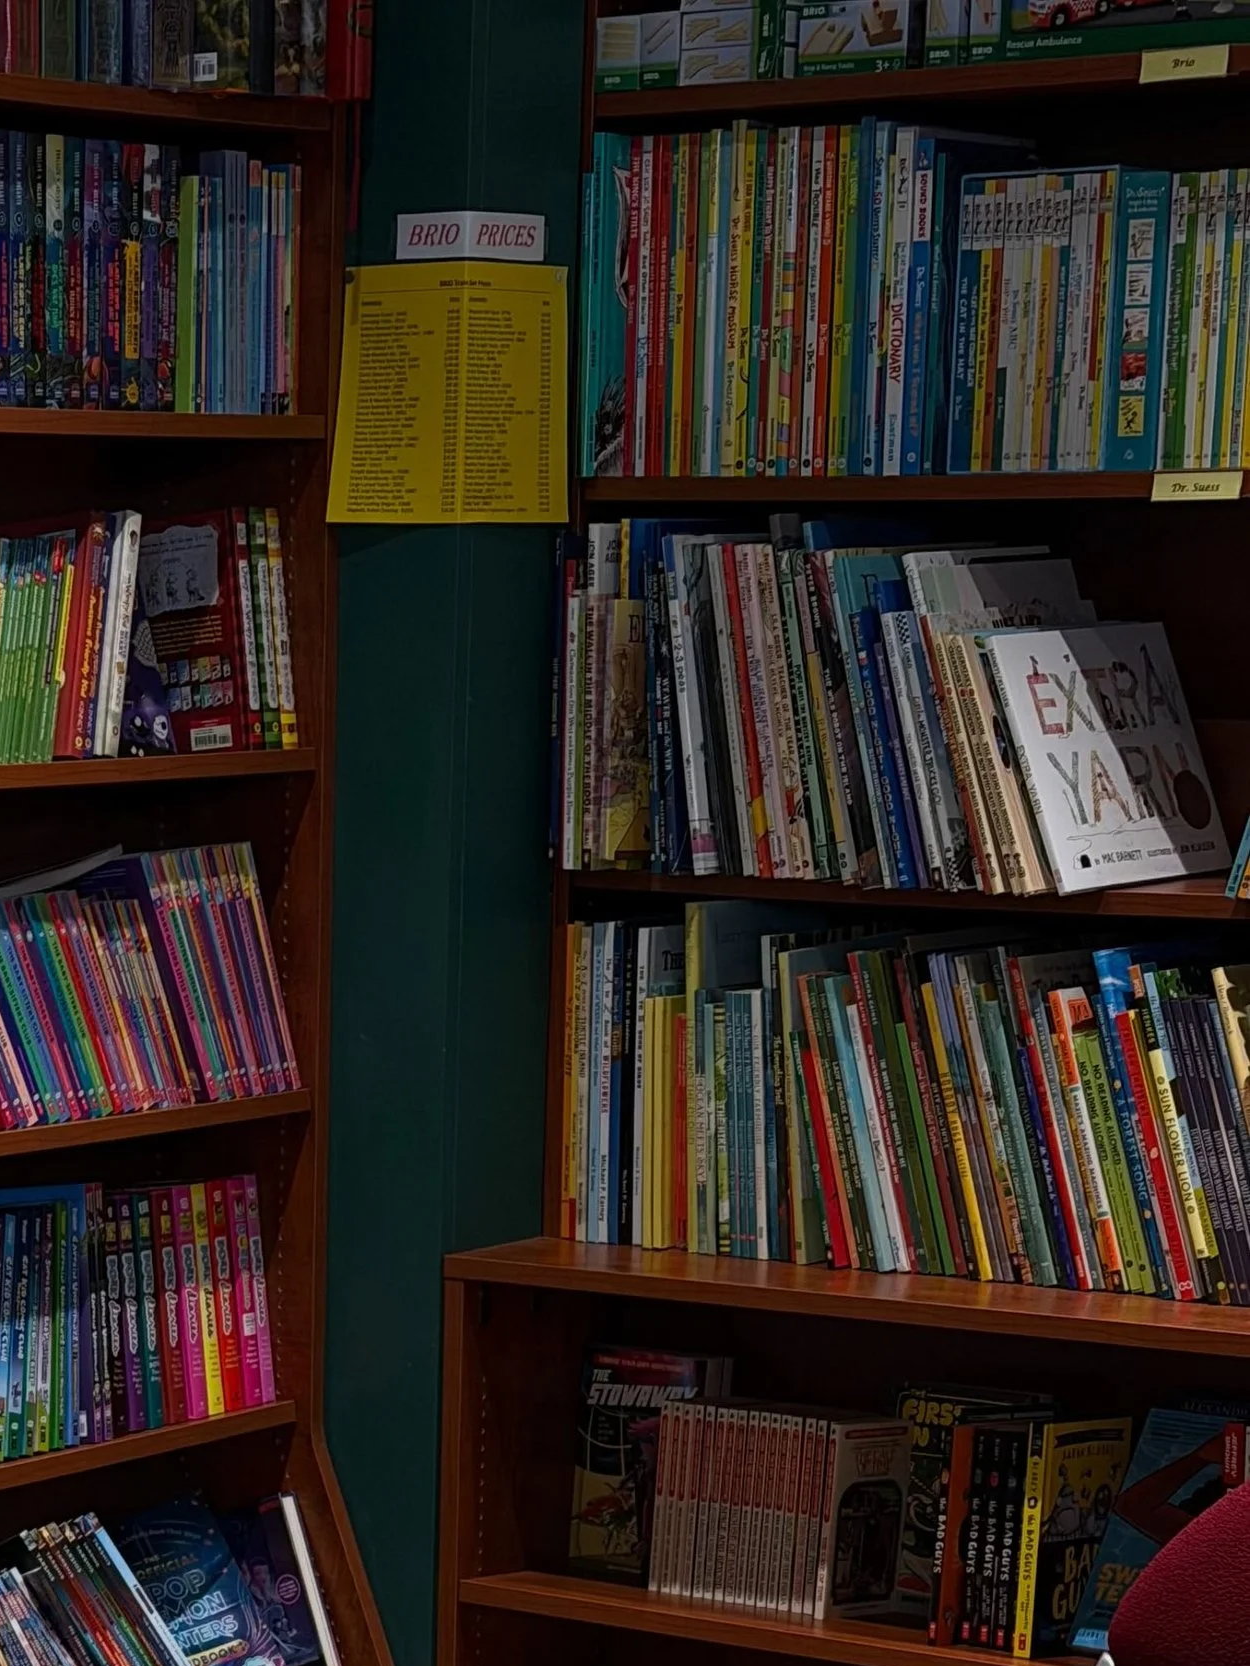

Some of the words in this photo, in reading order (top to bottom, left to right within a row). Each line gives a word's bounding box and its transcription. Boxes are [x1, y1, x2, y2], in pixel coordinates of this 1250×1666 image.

[918, 173, 928, 206] SOUND
[408, 223, 460, 246] BRIO
[476, 225, 536, 248] PRICES
[917, 207, 927, 238] BOOKS
[888, 302, 904, 384] DICTIONARY
[1171, 482, 1191, 493] Dr.
[1026, 642, 1182, 737] EXTRA
[1026, 781, 1043, 815] YARN
[1046, 742, 1191, 826] YARN
[1157, 1087, 1171, 1114] SUN
[1081, 1080, 1098, 1119] READING
[1093, 1119, 1109, 1161] ALLOWED
[1095, 1082, 1113, 1123] READING
[1107, 1124, 1122, 1165] ALLOWED
[1120, 1109, 1139, 1158] FOREST
[1162, 1115, 1184, 1162] FLOWER
[1129, 1161, 1148, 1201] SONG
[1175, 1164, 1192, 1203] LION
[591, 1368, 611, 1383] THE
[935, 1514, 947, 1540] BAD
[933, 1540, 945, 1574] GUYS
